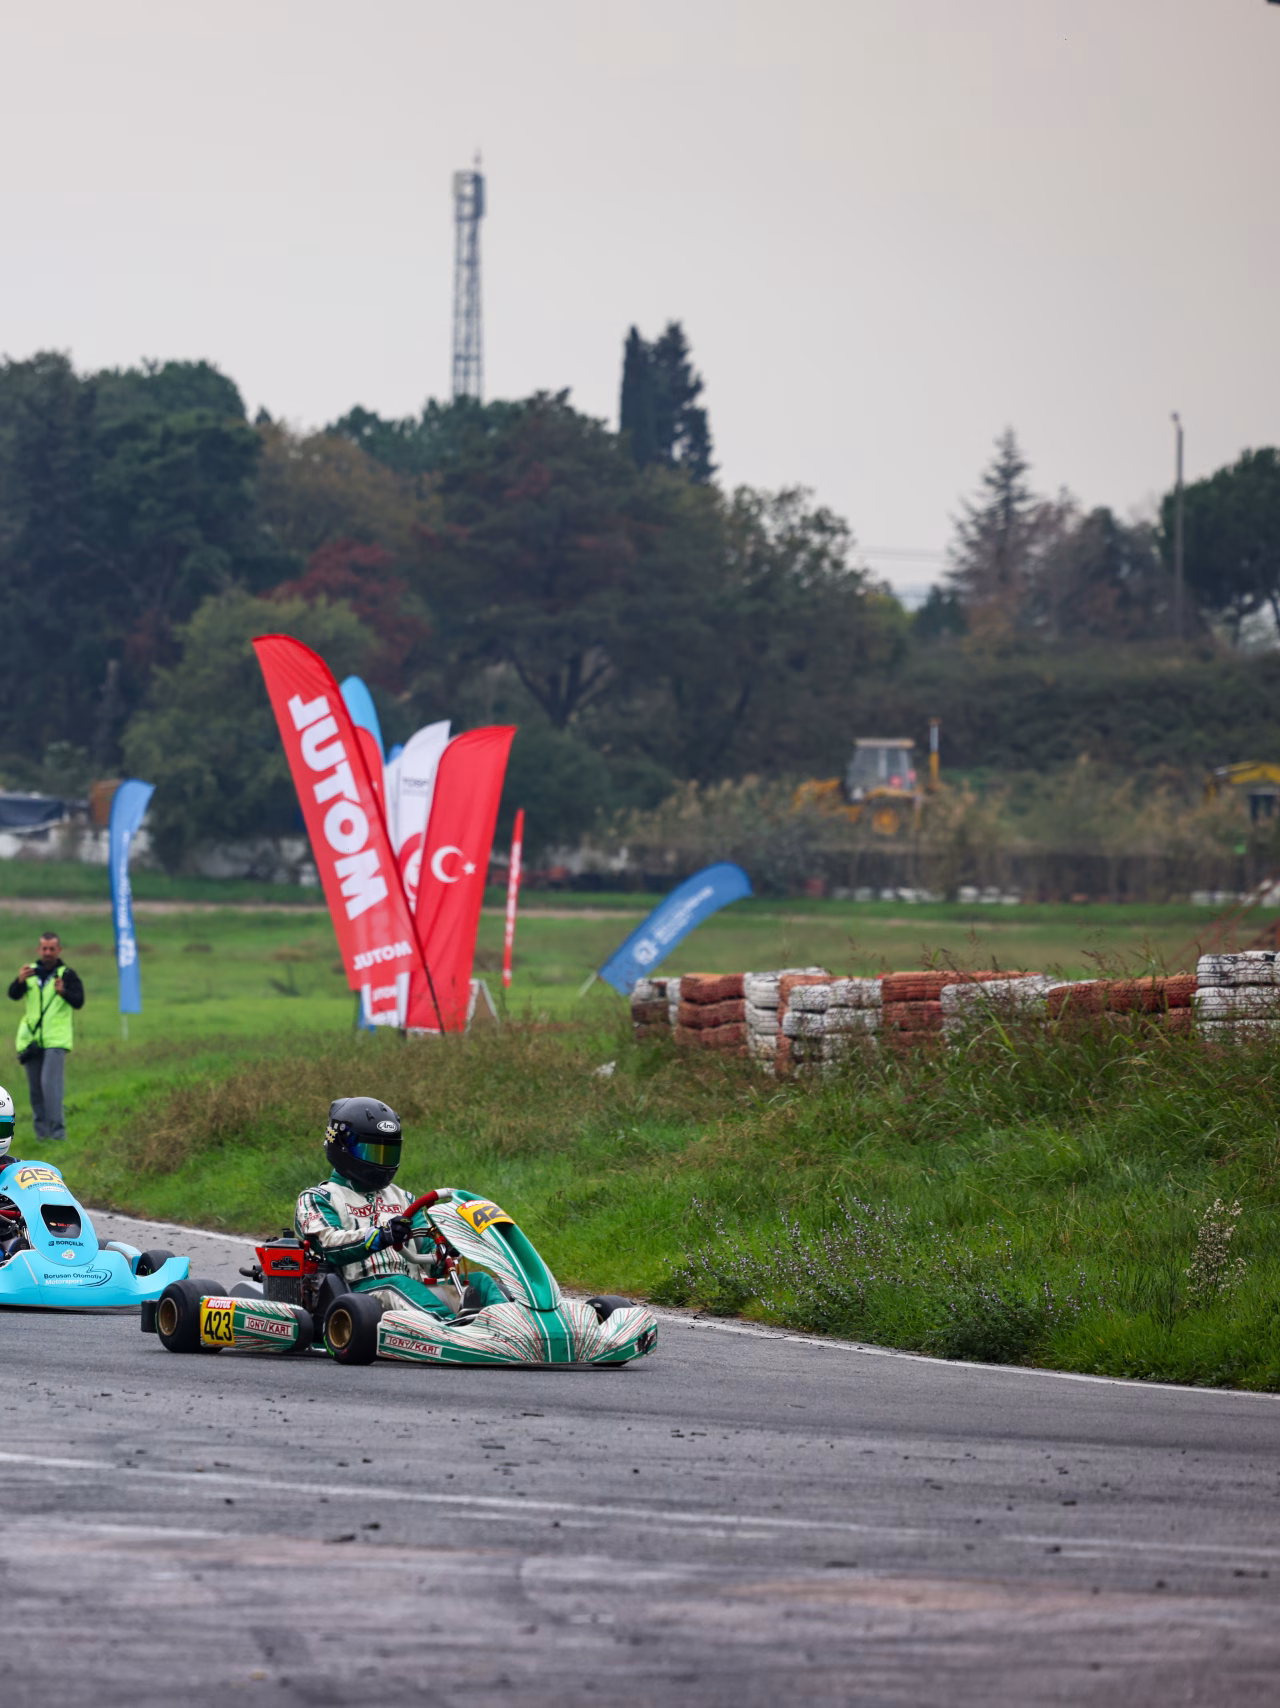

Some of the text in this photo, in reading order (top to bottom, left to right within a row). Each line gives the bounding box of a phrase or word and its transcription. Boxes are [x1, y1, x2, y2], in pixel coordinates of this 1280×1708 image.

[473, 1206, 509, 1227] 42
[72, 1272, 102, 1280] Otomotiv
[207, 1299, 232, 1309] MOTUL
[204, 1311, 232, 1341] 423
